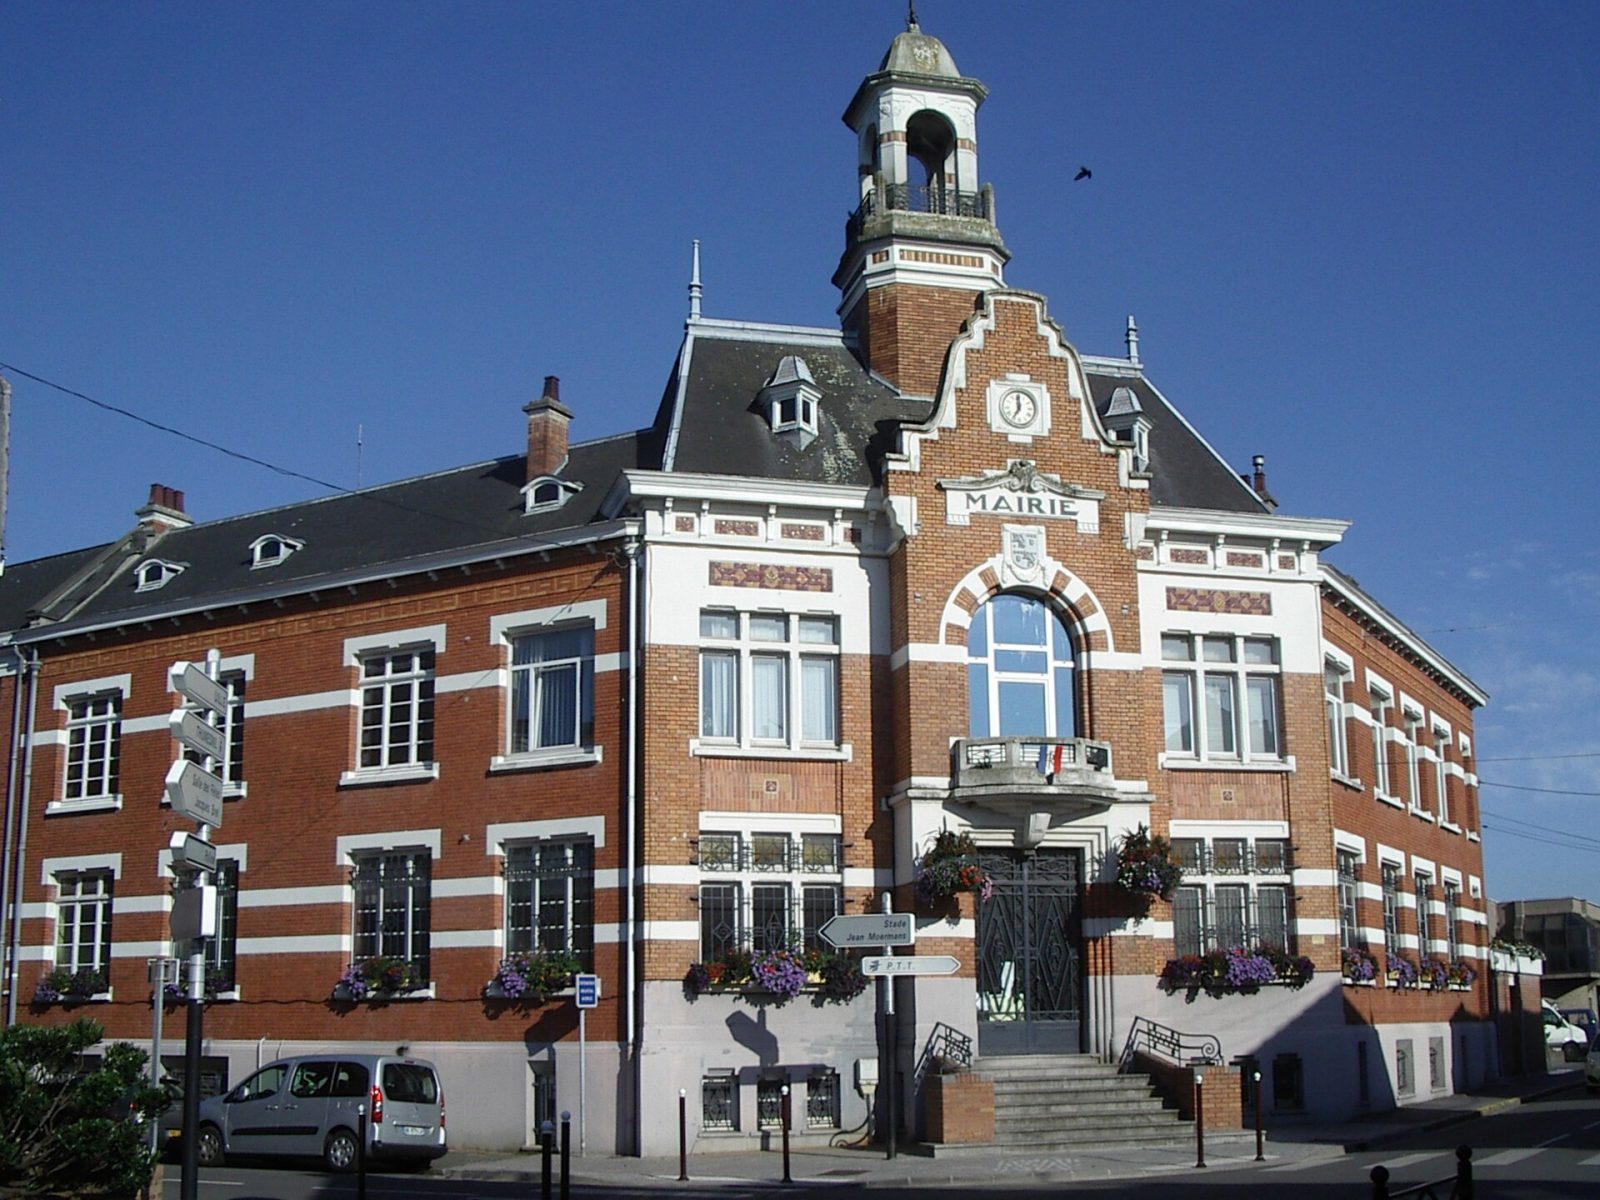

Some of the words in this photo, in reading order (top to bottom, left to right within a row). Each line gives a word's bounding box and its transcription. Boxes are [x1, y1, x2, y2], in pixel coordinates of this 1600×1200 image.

[965, 492, 1079, 516] MAIRIE
[883, 920, 907, 929] Stade
[846, 933, 865, 941] Jean
[868, 932, 907, 941] Moermans
[886, 961, 916, 970] P.T.T.
